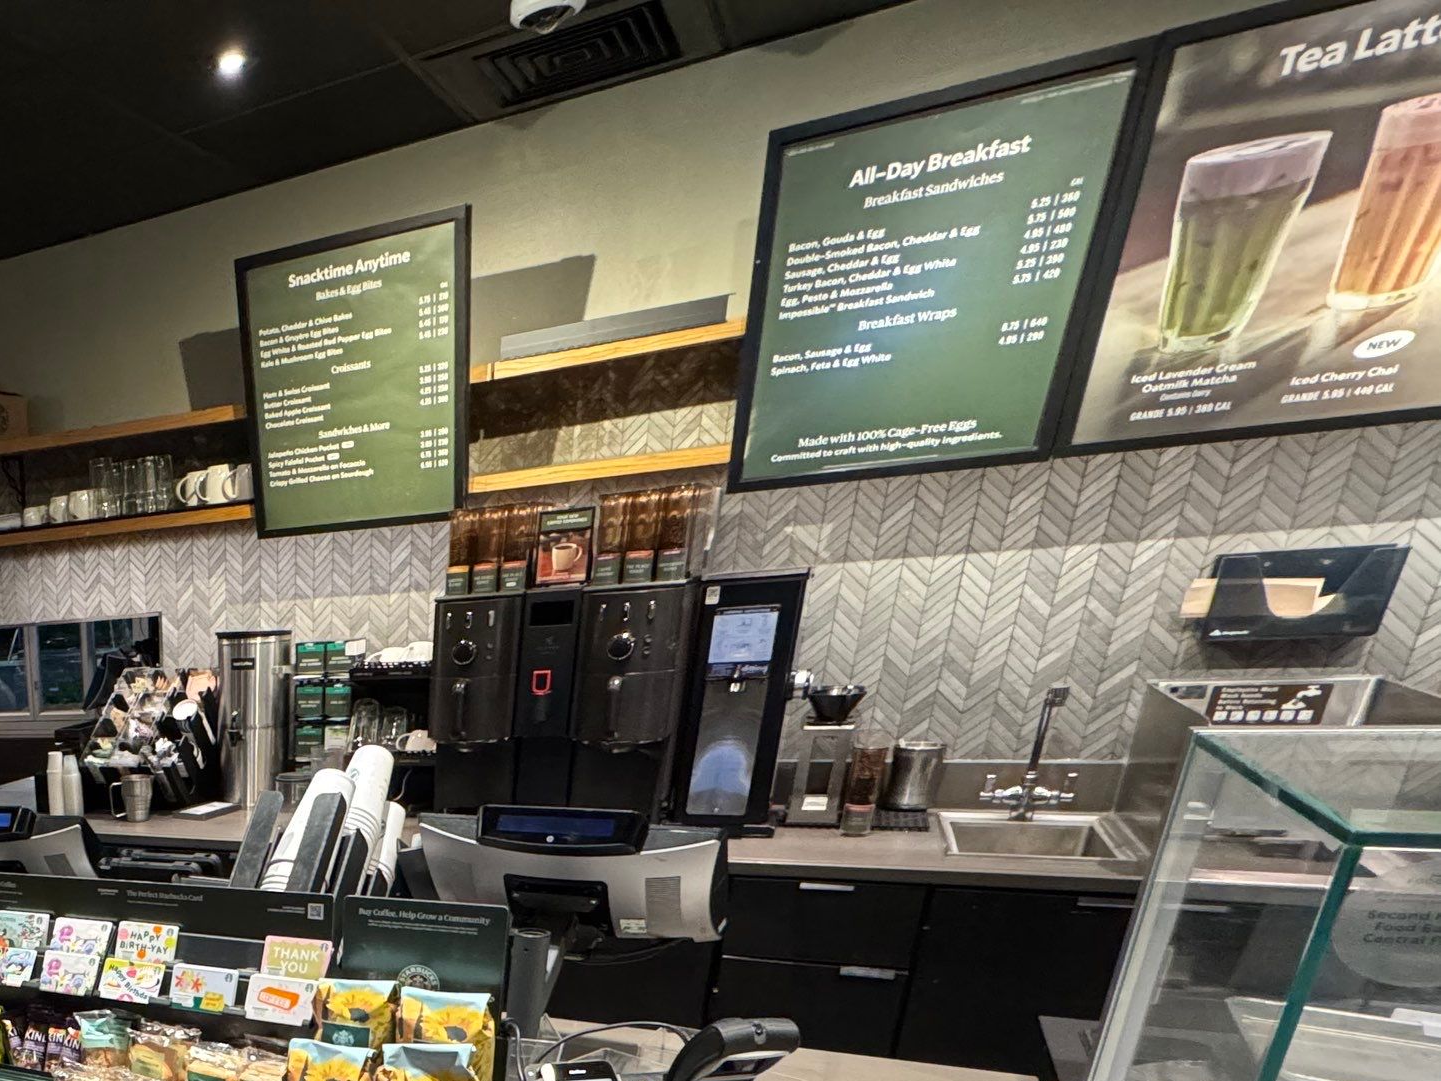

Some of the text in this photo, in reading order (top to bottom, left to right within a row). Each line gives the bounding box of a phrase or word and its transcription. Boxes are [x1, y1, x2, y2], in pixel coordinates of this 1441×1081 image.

[1280, 14, 1441, 77] Tea Latt
[849, 134, 1032, 188] All-Day Breakfast
[863, 170, 1005, 209] Breakfast Sandwiches
[786, 225, 981, 267] Double-Smoked Bacon, Cheddar & Egg
[788, 228, 886, 253] Bacon, Gouda & Egg
[288, 251, 411, 288] Snacktime Anytime
[783, 257, 957, 294] Turkey Bacon, Cheddar & Egg White
[784, 253, 900, 280] Sausage, Cheddar & Egg
[316, 280, 382, 301] Bakes & Egg Bites
[802, 292, 829, 304] Pesto
[830, 289, 837, 299] &
[840, 281, 893, 298] Mozzarella
[836, 297, 884, 311] Breakfast
[885, 288, 935, 304] Sandwich
[858, 306, 957, 331] Breakfast Wraps
[772, 343, 872, 363] Bacon, Sausage & Egg
[1367, 338, 1402, 350] NEW
[331, 360, 371, 374] Croissants
[770, 352, 892, 377] Spinach, Feta & Egg White
[1131, 361, 1257, 384] Iced Lavender Cream
[1289, 364, 1400, 386] Iced Cherry Chai
[1142, 374, 1237, 394] Oatmilk Matcha
[1281, 391, 1321, 404] GRANDE
[1129, 408, 1164, 421] GRANDE
[318, 421, 390, 439] Sandwiches & More
[797, 419, 977, 449] Made with 100% Cage-Free Eggs
[770, 431, 1003, 463] Committed to craft with high-quality ingredients.
[359, 907, 372, 916] Buy
[399, 911, 416, 920] Help
[417, 912, 437, 920] Grow
[444, 915, 490, 926] Community
[130, 931, 161, 943] HAPPY
[273, 947, 320, 962] THANK
[109, 964, 127, 982] Happy
[280, 960, 308, 974] YOU
